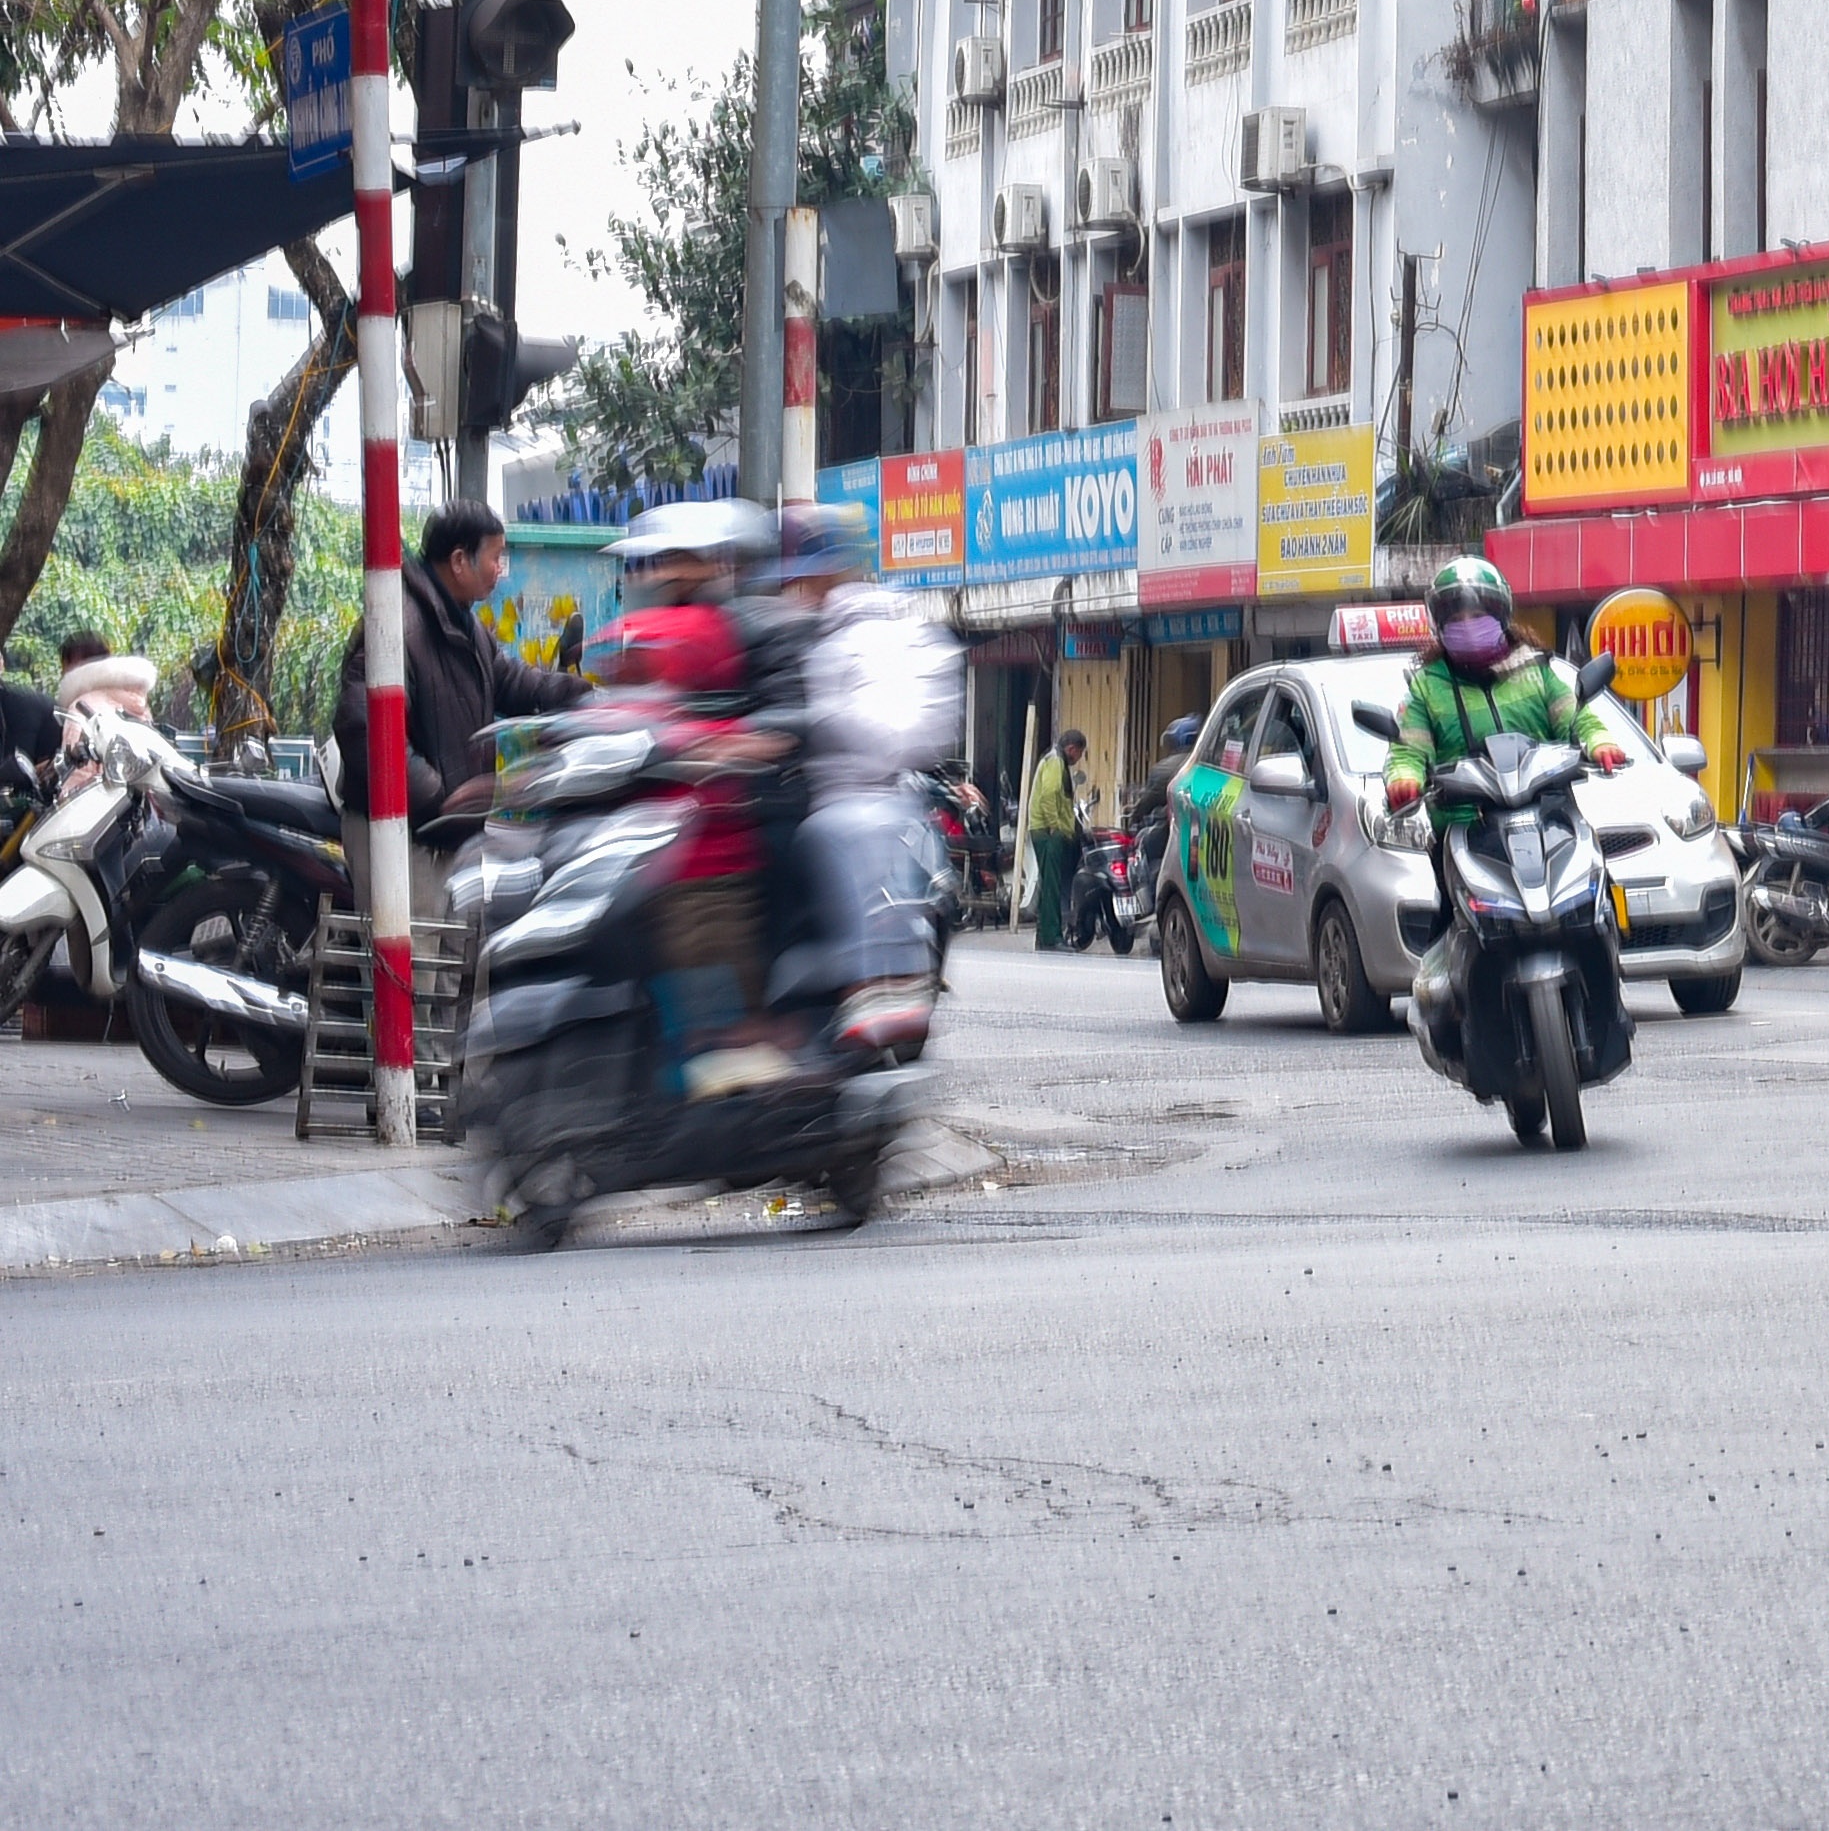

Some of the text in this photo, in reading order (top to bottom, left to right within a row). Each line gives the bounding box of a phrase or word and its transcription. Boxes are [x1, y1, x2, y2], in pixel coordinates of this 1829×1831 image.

[312, 21, 335, 67] PHỐ
[1715, 352, 1753, 422] BIA
[1186, 445, 1203, 489] HẢI
[1206, 446, 1234, 485] PHÁT
[1065, 468, 1135, 540] KOYO
[1280, 526, 1347, 558] BẢO HÀNH 2 NĂM
[1352, 633, 1373, 641] TAXI
